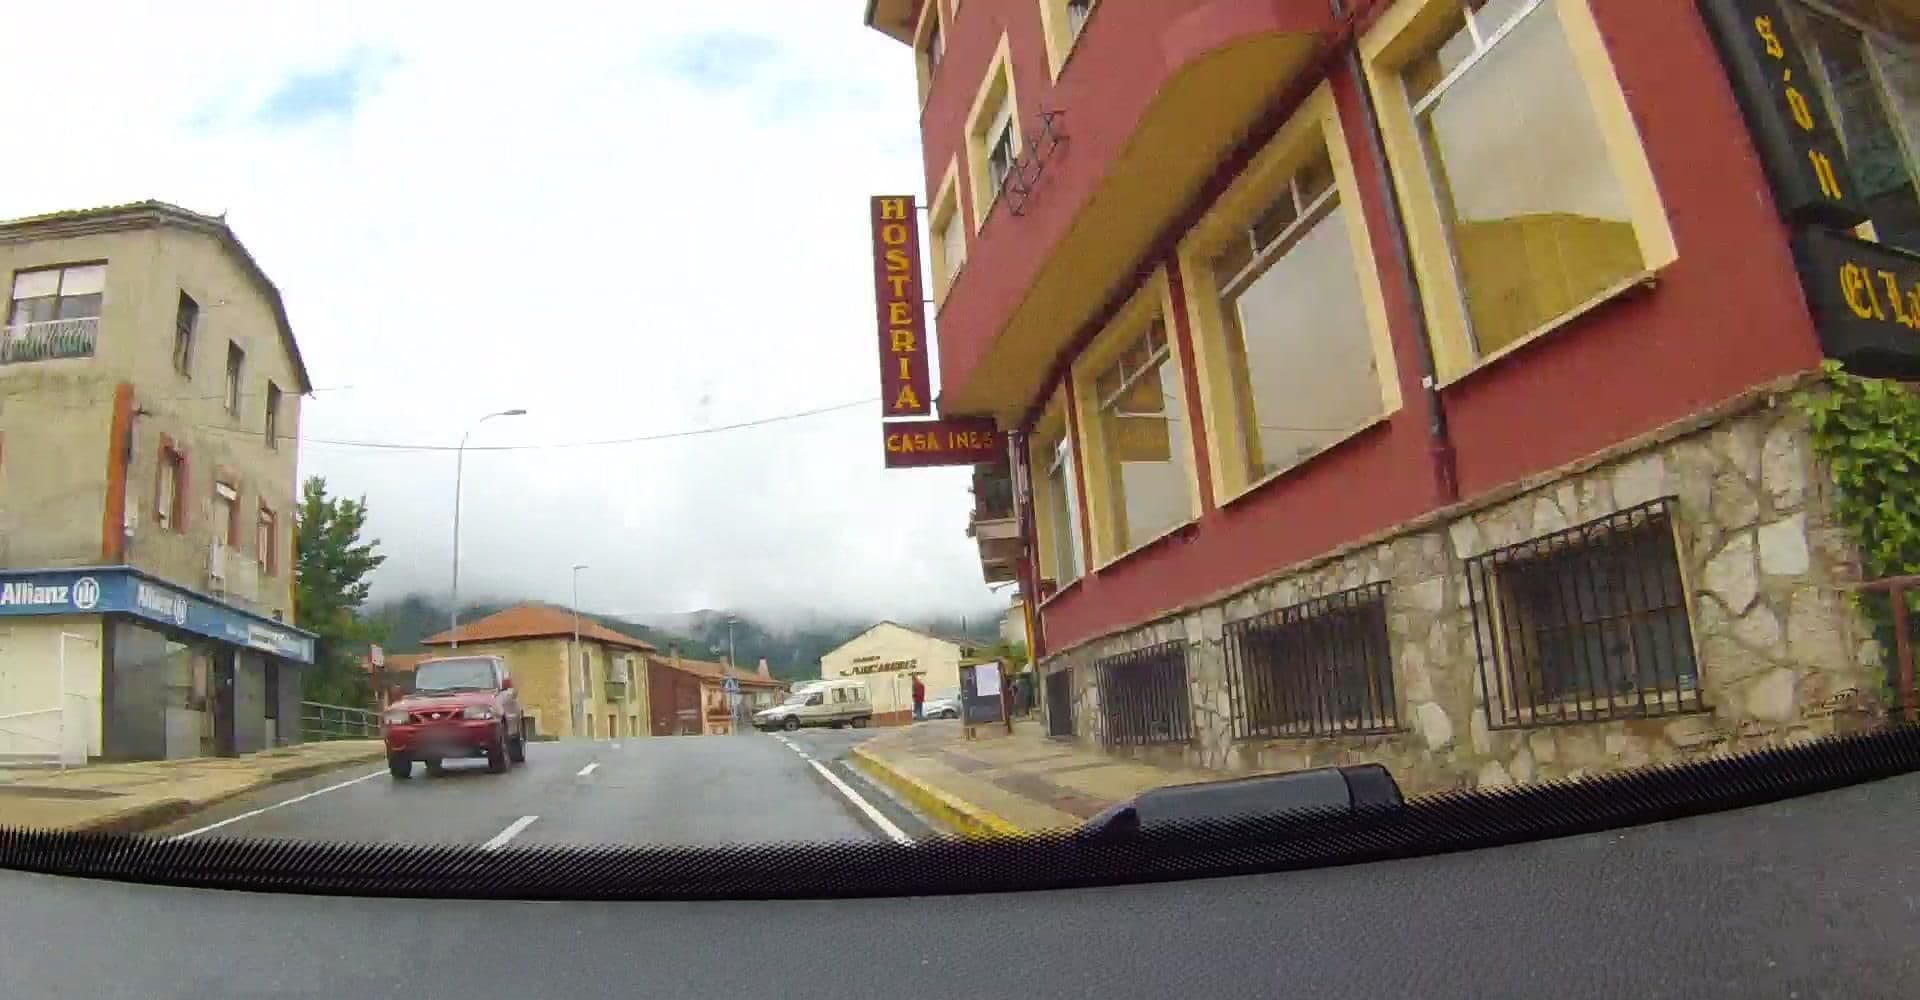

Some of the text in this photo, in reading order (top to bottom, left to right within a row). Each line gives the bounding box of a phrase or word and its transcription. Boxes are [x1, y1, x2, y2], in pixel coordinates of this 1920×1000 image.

[879, 198, 922, 410] HOSTERIA
[1840, 261, 1885, 321] El
[886, 431, 993, 454] CASA INES
[0, 581, 69, 606] Allianz
